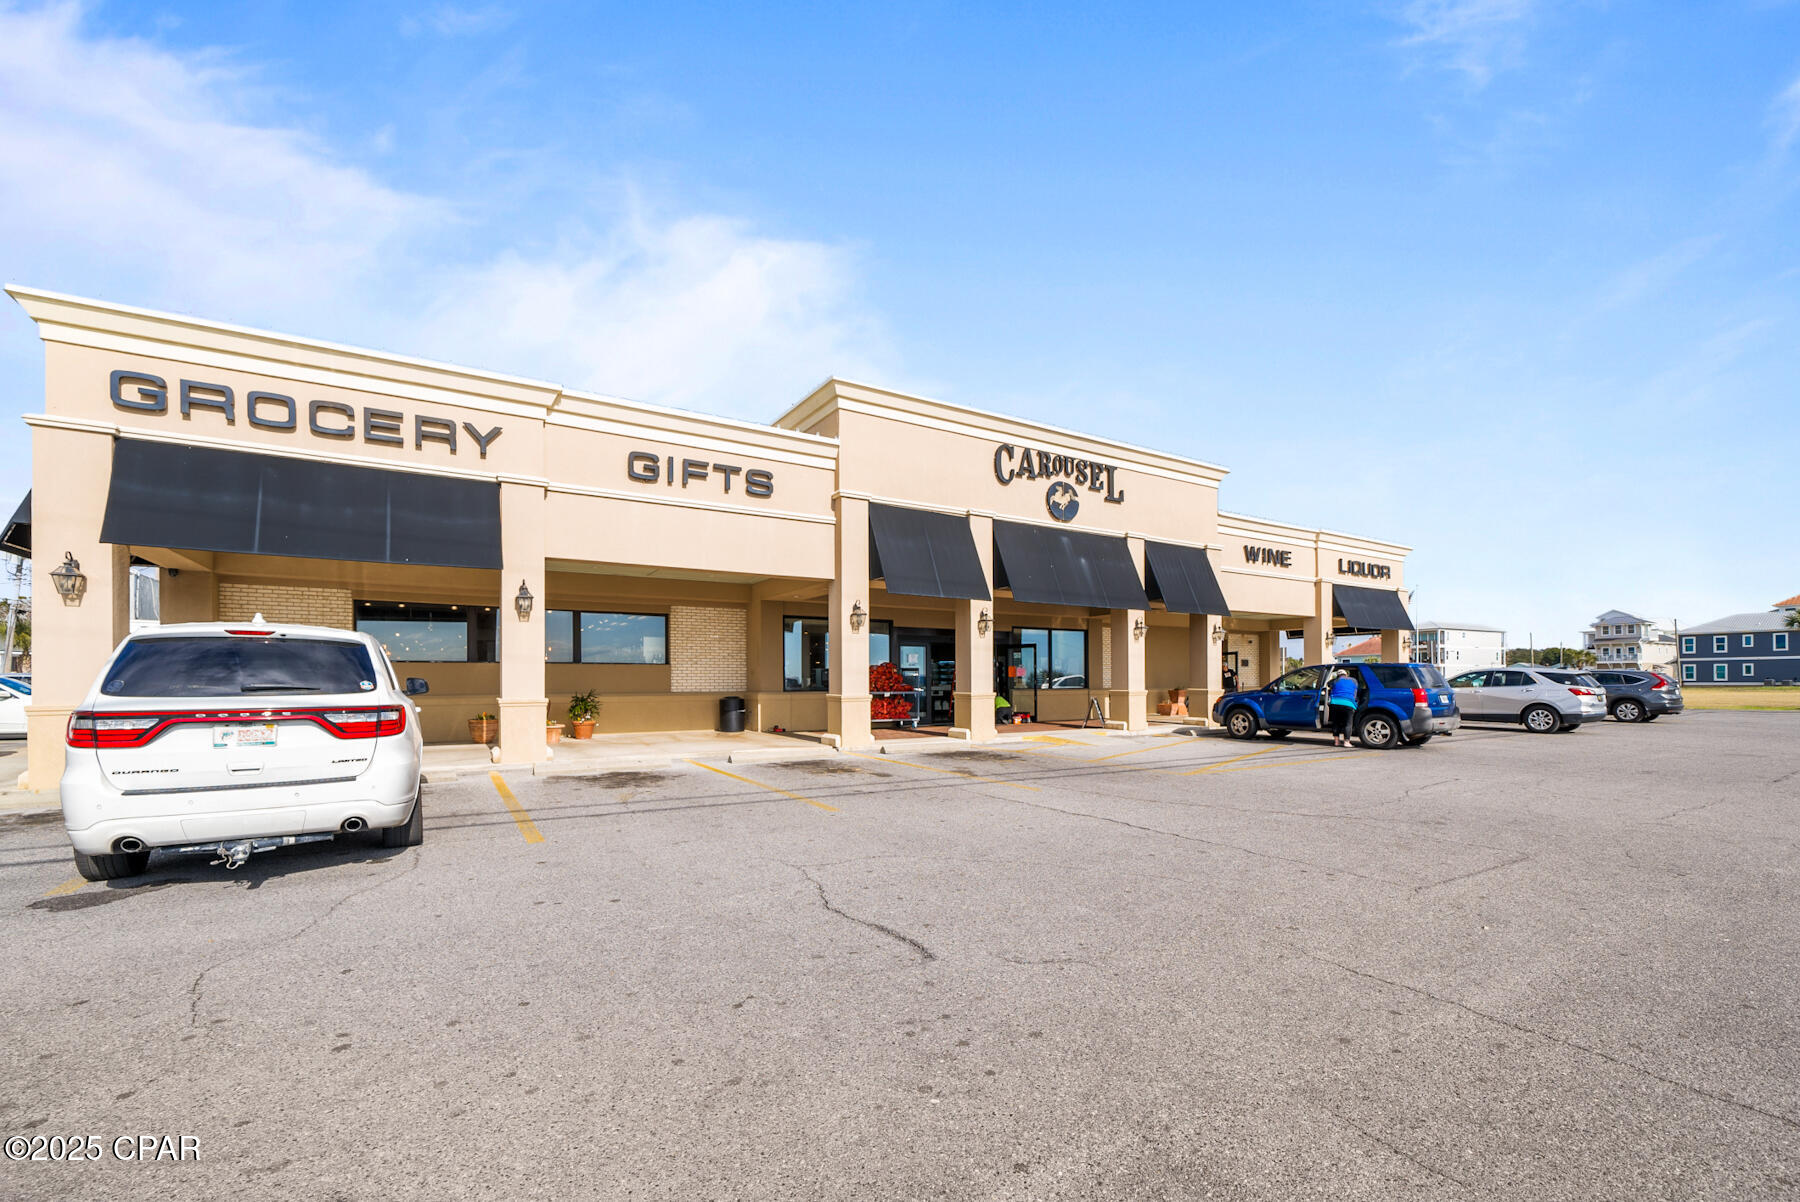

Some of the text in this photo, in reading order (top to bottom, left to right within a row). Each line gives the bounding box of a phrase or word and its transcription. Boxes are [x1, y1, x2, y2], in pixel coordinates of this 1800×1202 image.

[109, 369, 503, 459] GROCERY
[627, 451, 774, 498] GIFTS
[994, 443, 1125, 503] CAROUSEL
[1243, 545, 1292, 568] WINE
[1338, 558, 1391, 580] LIQUOR
